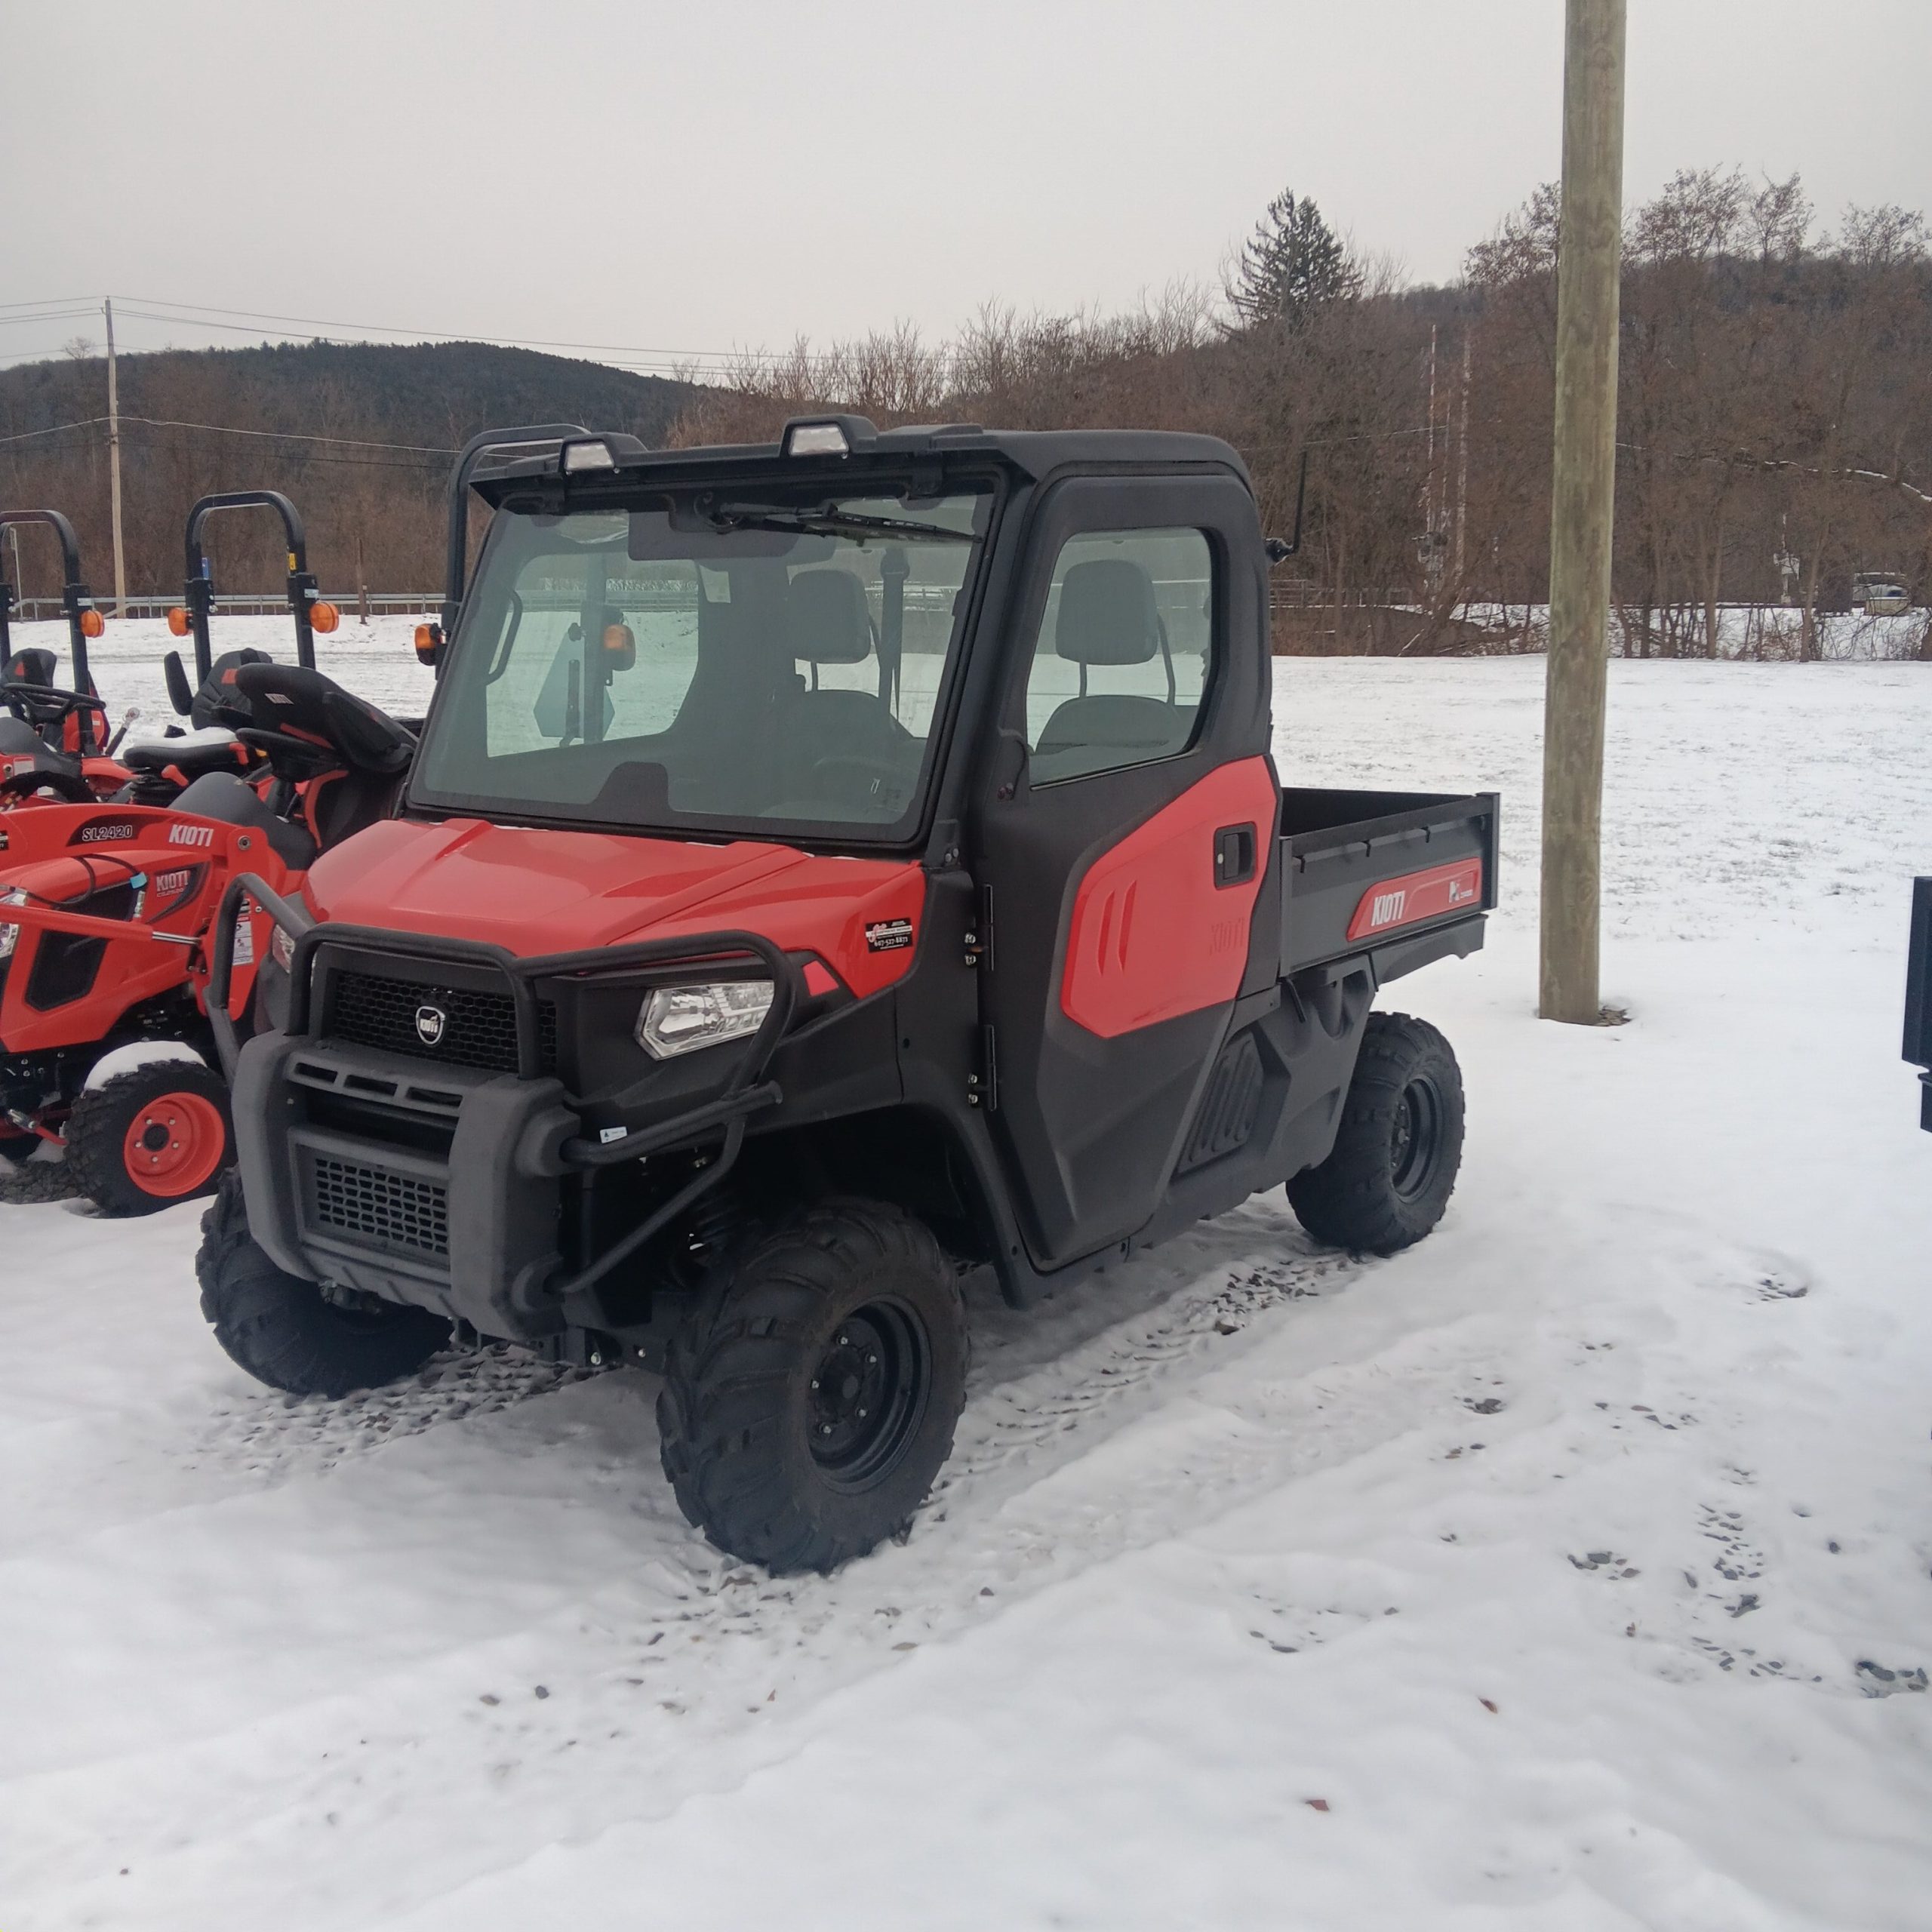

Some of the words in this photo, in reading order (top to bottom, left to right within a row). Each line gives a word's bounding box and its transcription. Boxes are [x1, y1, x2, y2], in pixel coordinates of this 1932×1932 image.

[82, 825, 133, 841] SL2420
[168, 824, 214, 847] KIOTI
[156, 870, 189, 892] KIOTI
[1371, 890, 1406, 927] KIOTI
